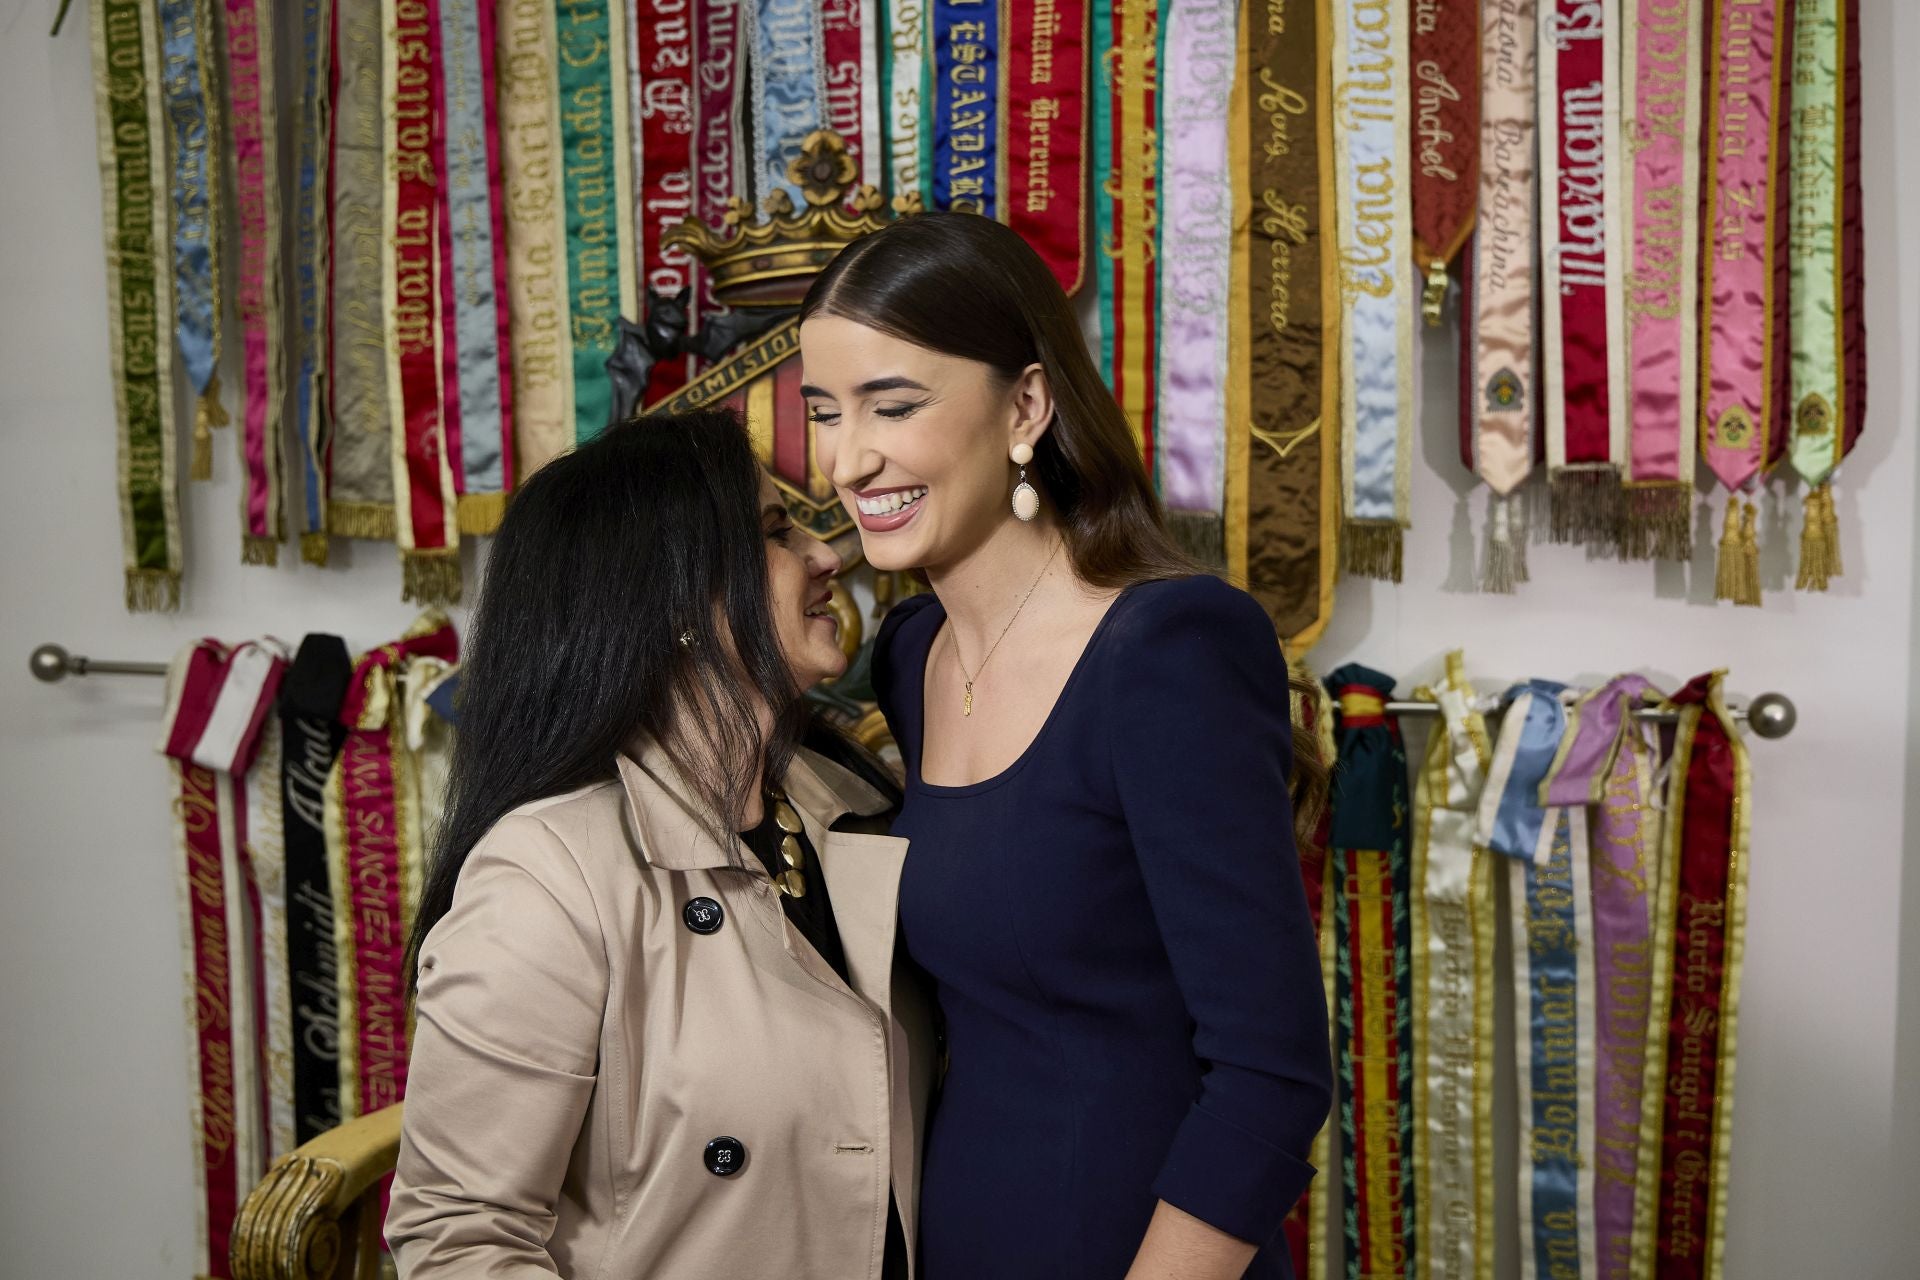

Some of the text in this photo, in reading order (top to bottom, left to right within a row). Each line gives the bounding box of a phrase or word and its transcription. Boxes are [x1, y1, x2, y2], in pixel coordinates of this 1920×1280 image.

[104, 0, 148, 112] Cam
[1258, 66, 1307, 164] Roig
[1414, 0, 1461, 182] ia Anchel
[565, 83, 615, 350] Inmaculada
[891, 86, 920, 195] alles
[1022, 97, 1060, 213] Herencia
[1488, 117, 1525, 297] Barrachina
[396, 203, 433, 357] Maria
[519, 222, 561, 390] Maria
[1262, 188, 1308, 334] Herrero
[1336, 154, 1396, 306] Elena
[351, 735, 383, 799] ANA
[1528, 970, 1587, 1169] Bolumar
